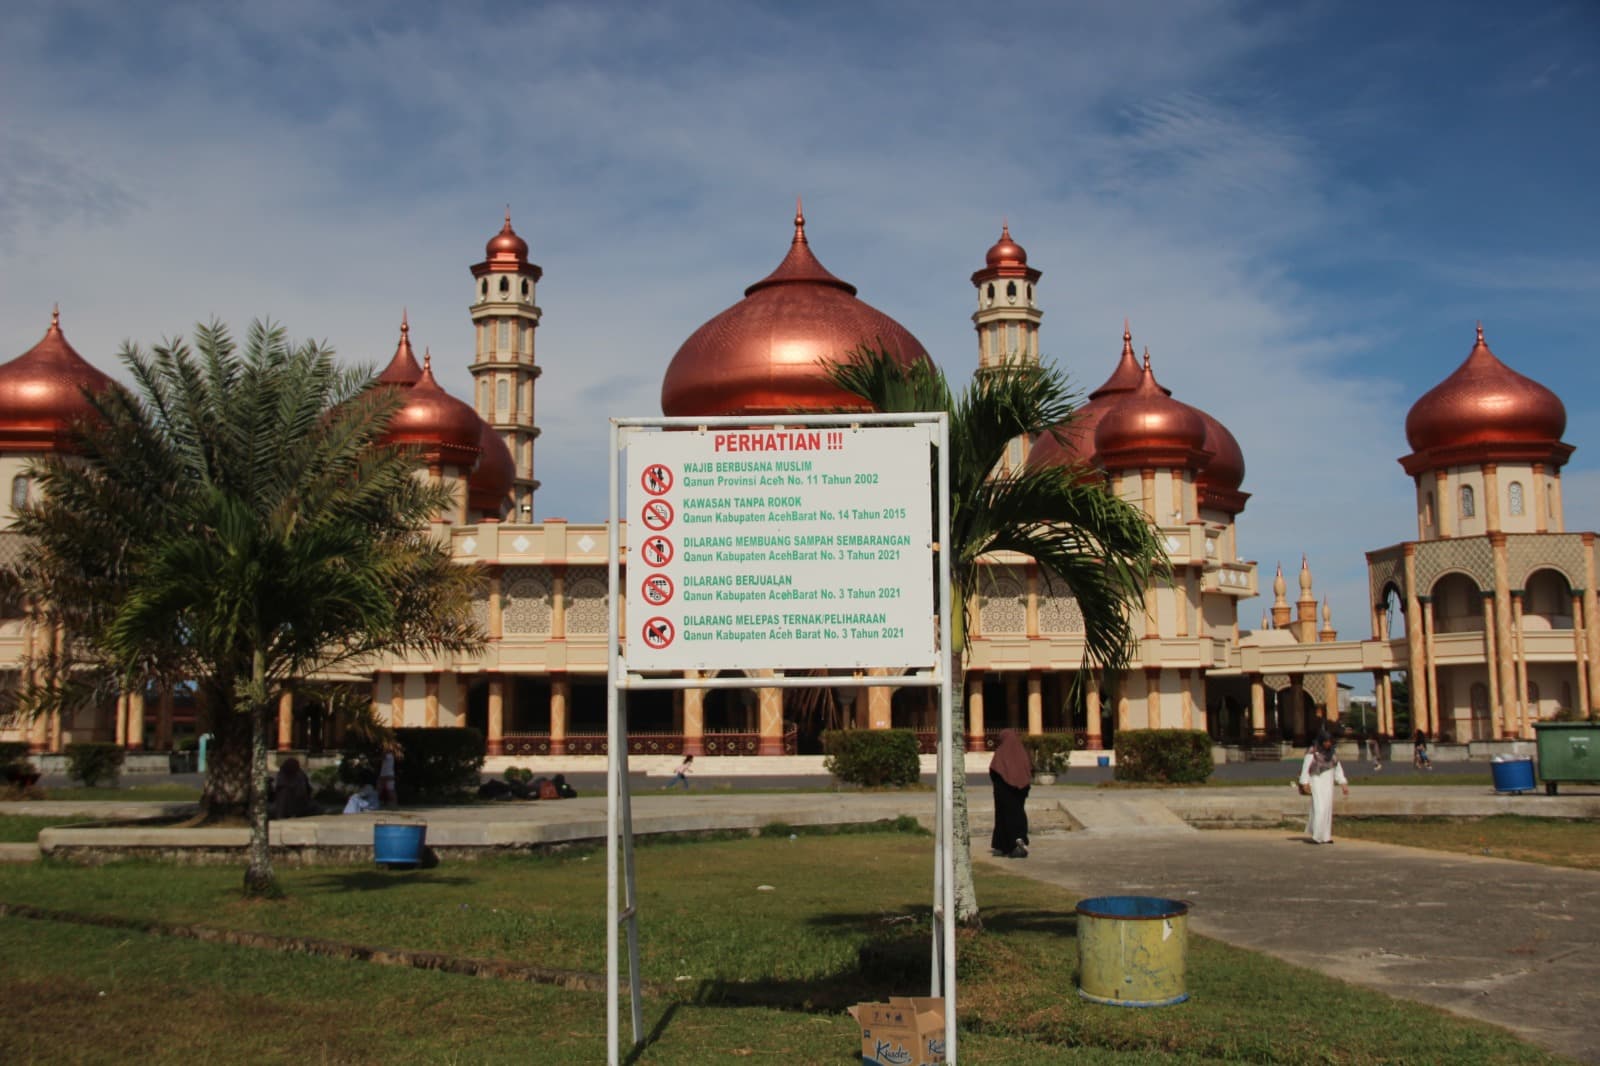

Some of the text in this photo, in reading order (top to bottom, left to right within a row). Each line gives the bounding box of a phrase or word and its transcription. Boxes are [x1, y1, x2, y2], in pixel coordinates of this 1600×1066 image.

[714, 432, 843, 452] PERHATIAN !!!
[684, 460, 812, 473] WAJIB BERBUSANA MUSLIM
[683, 473, 879, 487] Qanun Provinsi Aceh No. 11 Tahun 2002
[683, 496, 802, 508] KAWASAN TANPA ROKOK
[683, 512, 713, 523] Qanun
[716, 512, 765, 525] Kabupaten
[819, 510, 835, 520] No.
[838, 509, 849, 520] 14
[852, 509, 880, 519] Tahun
[883, 508, 906, 519] 2015
[683, 535, 911, 547] DILARANG MEMBUANG SAMPAH SEMBARANGAN
[683, 552, 713, 562] Qanun
[716, 551, 766, 564] Kabupaten
[820, 550, 836, 560] No.
[839, 550, 844, 560] 3
[846, 549, 875, 560] Tahun
[878, 549, 900, 560] 2021
[683, 575, 792, 586] DILARANG BERJUALAN
[683, 590, 713, 601] Qanun
[716, 590, 766, 603] Kabupaten
[820, 588, 836, 599] No.
[839, 588, 844, 599] 3
[847, 588, 876, 599] Tahun
[878, 587, 901, 598] 2021
[683, 615, 733, 626] DILARANG
[735, 614, 780, 625] MELEPAS
[683, 627, 904, 643] Qanun Kabupaten Aceh Barat No. 3 Tahun 2021
